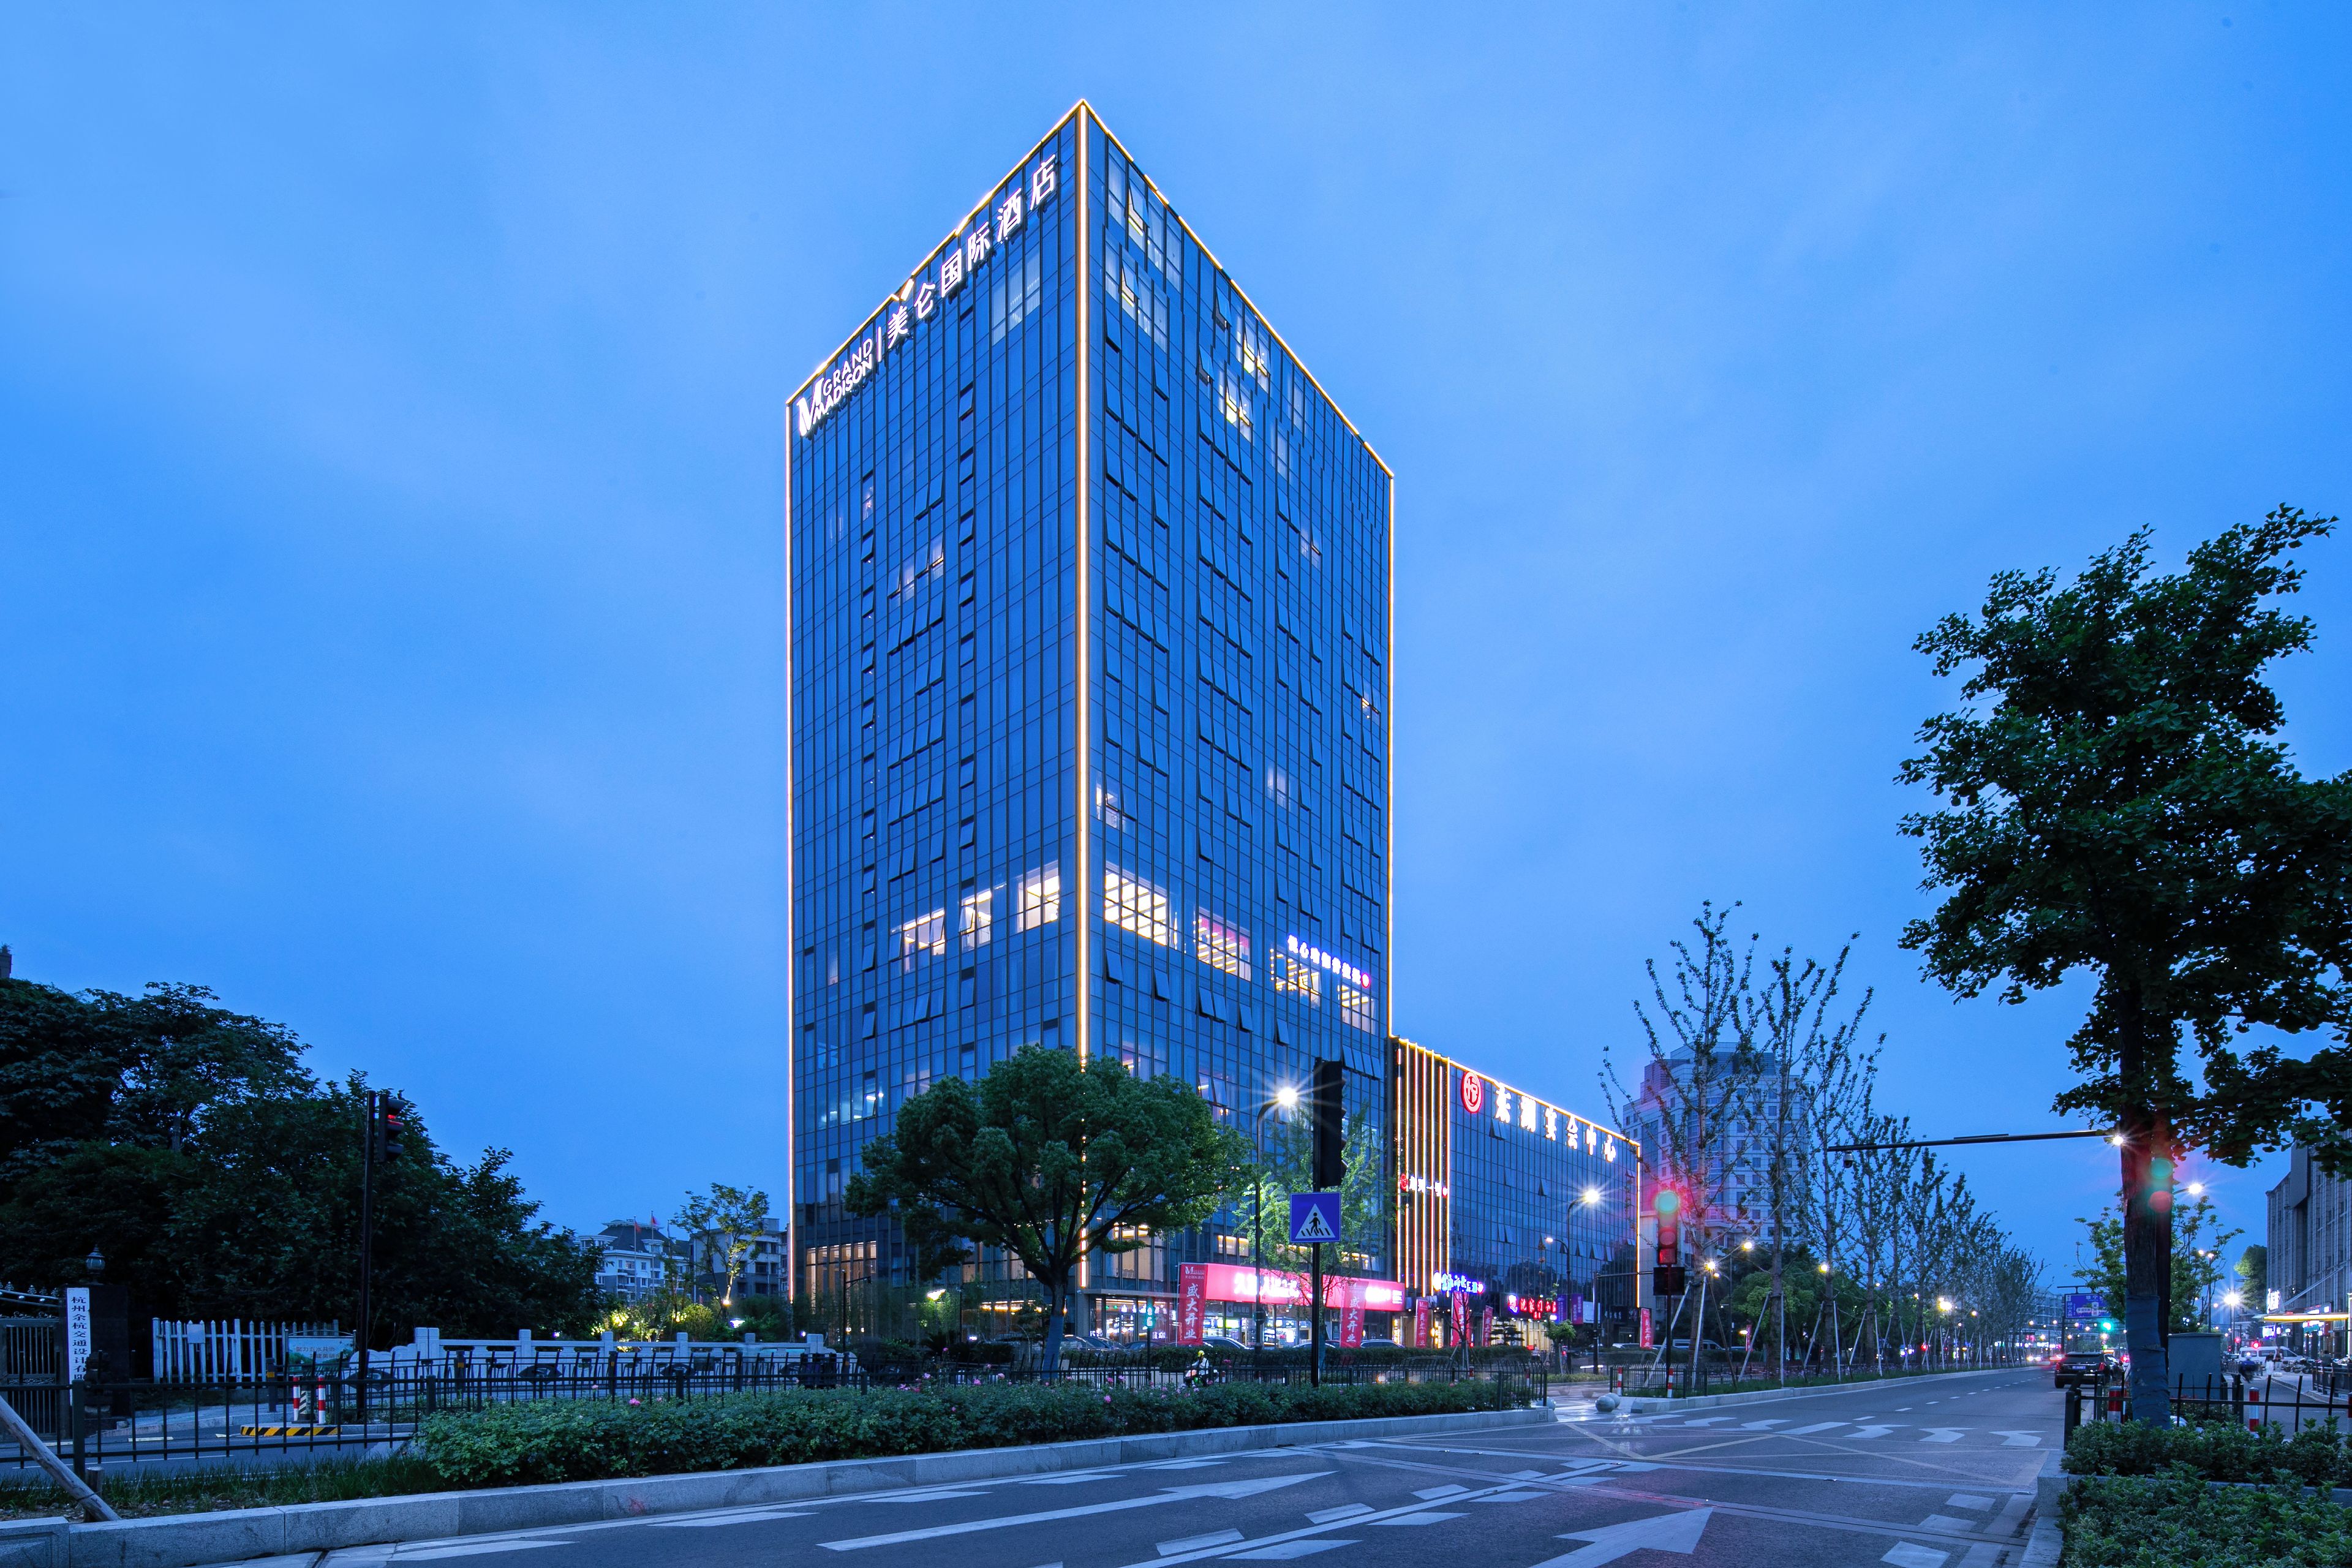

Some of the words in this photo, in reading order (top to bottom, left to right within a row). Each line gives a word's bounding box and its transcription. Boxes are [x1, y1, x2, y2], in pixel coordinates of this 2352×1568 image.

[887, 154, 1057, 349] 美仑国际酒店
[812, 353, 872, 425] MADISON
[823, 338, 873, 396] GRAND
[1184, 1283, 1200, 1340] 盛大开业
[1346, 1297, 1360, 1343] 盛大开业
